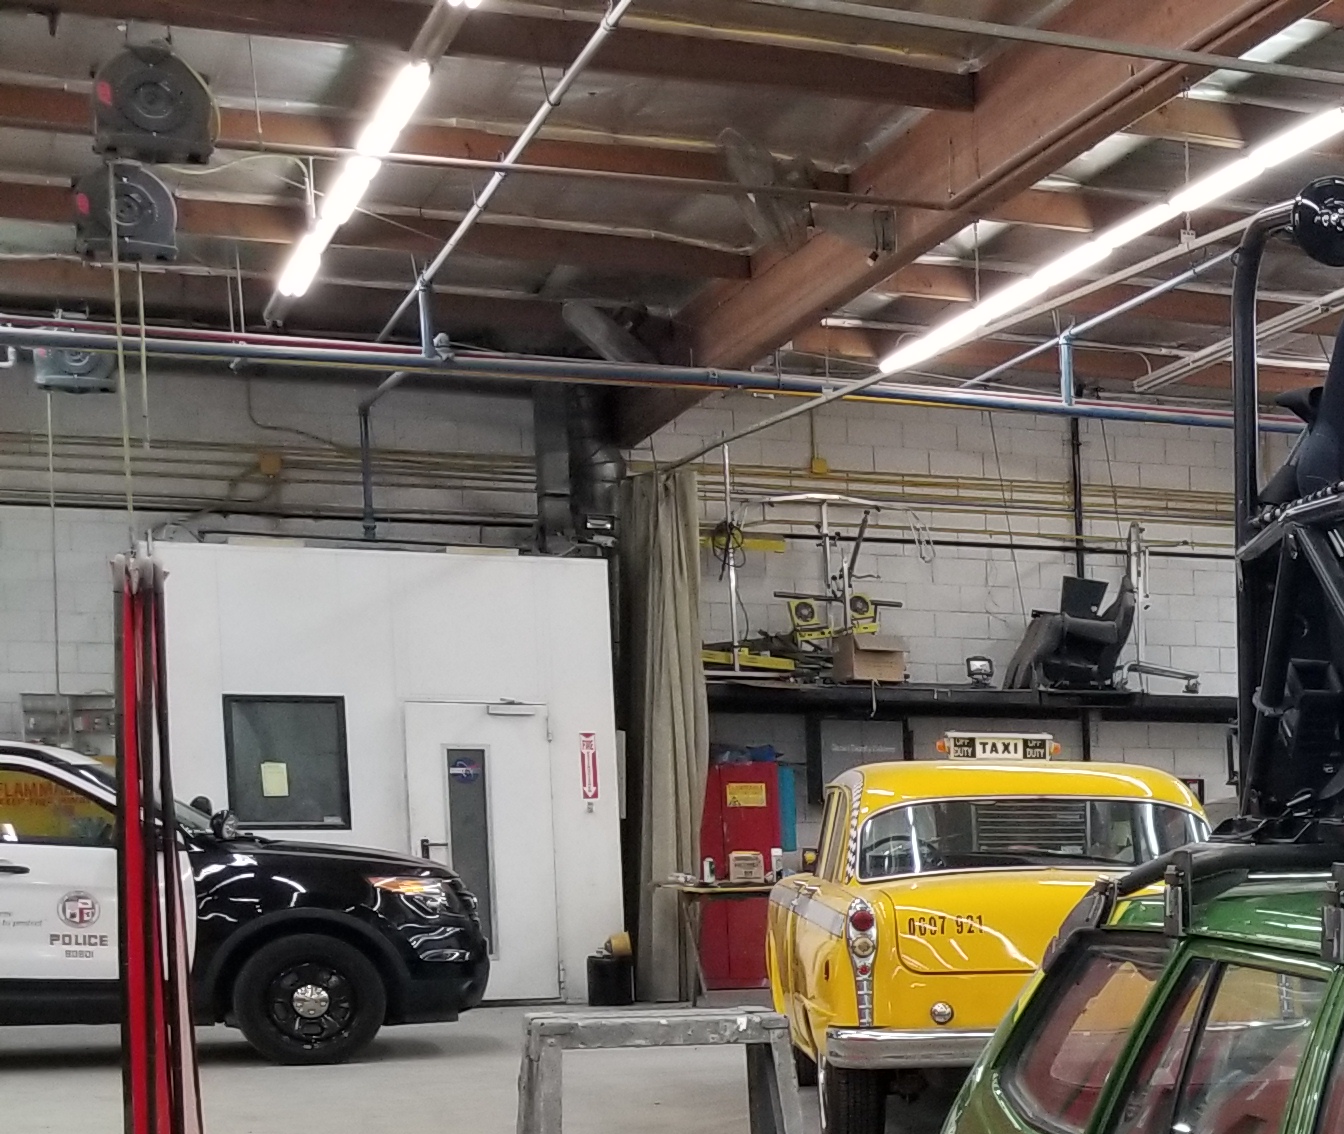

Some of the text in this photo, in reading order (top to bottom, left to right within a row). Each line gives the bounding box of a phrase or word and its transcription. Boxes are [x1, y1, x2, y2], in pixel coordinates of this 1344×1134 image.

[979, 741, 1019, 755] TAXI
[1026, 748, 1046, 758] DUTY
[955, 915, 984, 934] 921
[49, 933, 109, 947] POLICE
